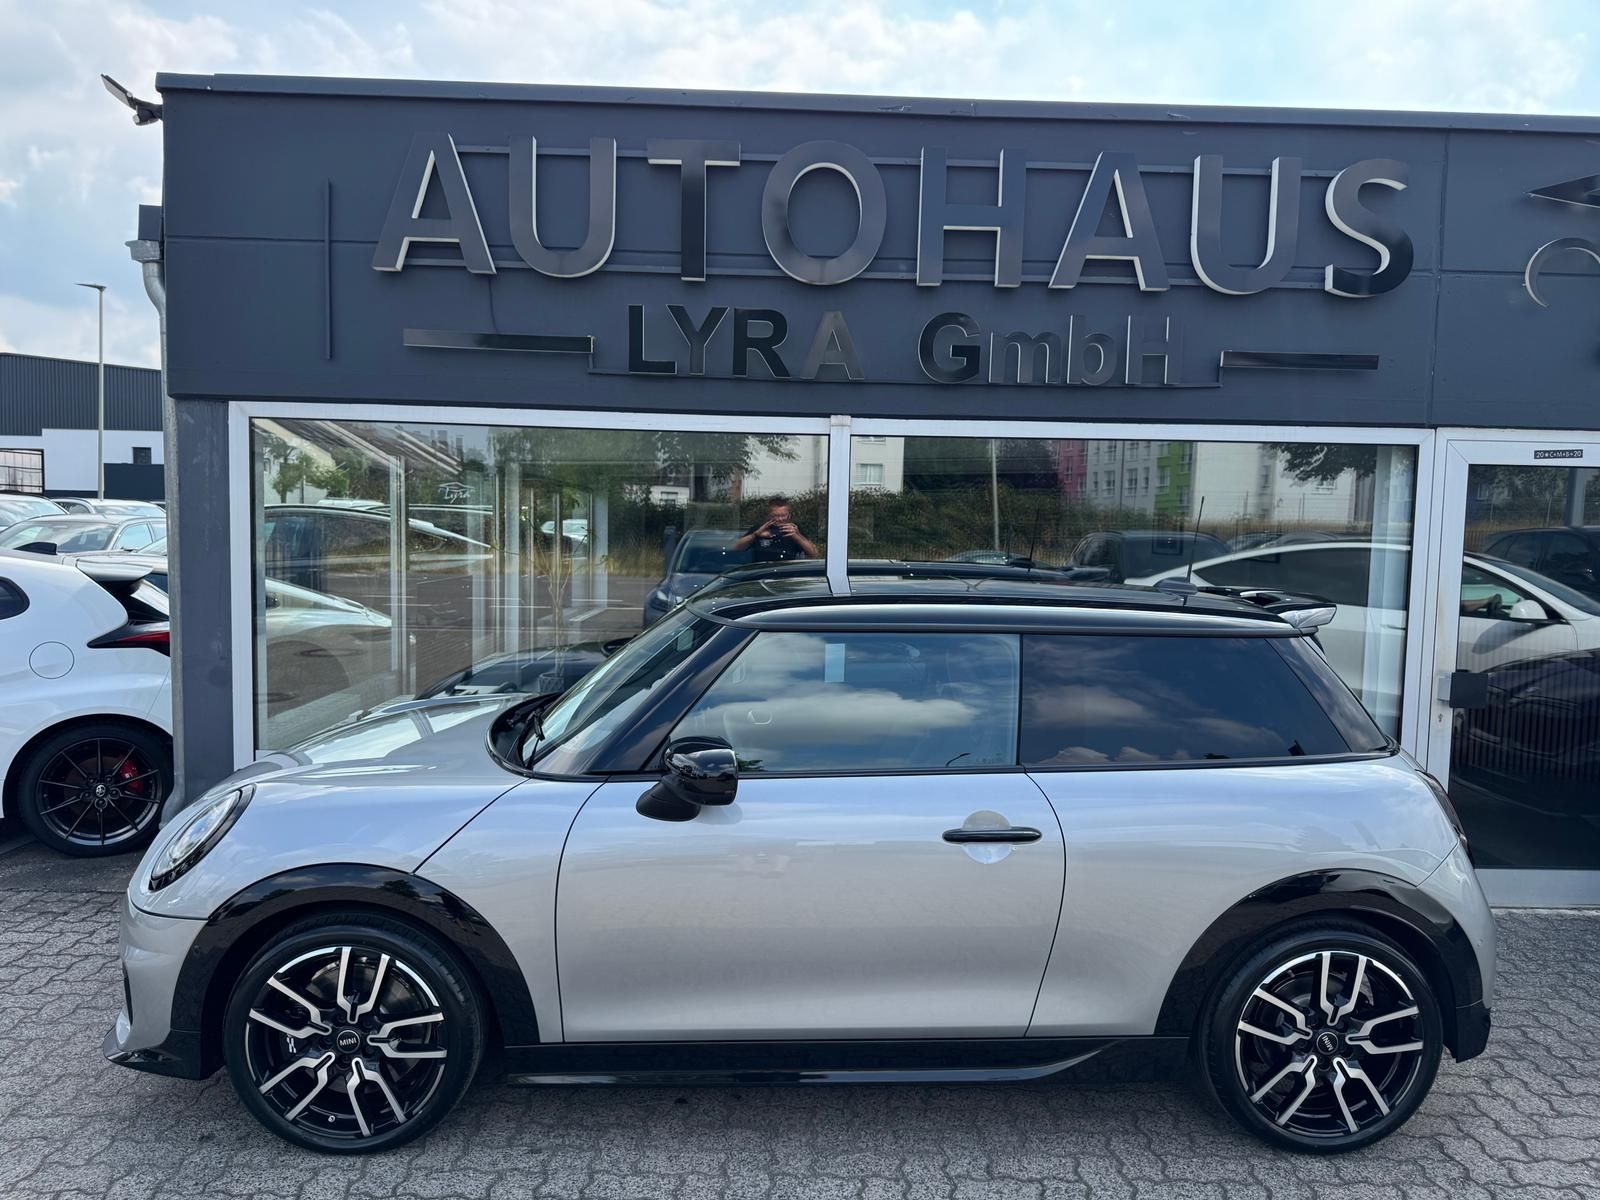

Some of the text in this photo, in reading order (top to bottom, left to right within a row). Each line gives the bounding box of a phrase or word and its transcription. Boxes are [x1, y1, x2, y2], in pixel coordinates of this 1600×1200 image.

[371, 133, 1414, 298] AUTOHAUS
[627, 303, 1184, 385] LYRA GmbH
[340, 1037, 357, 1046] MINI
